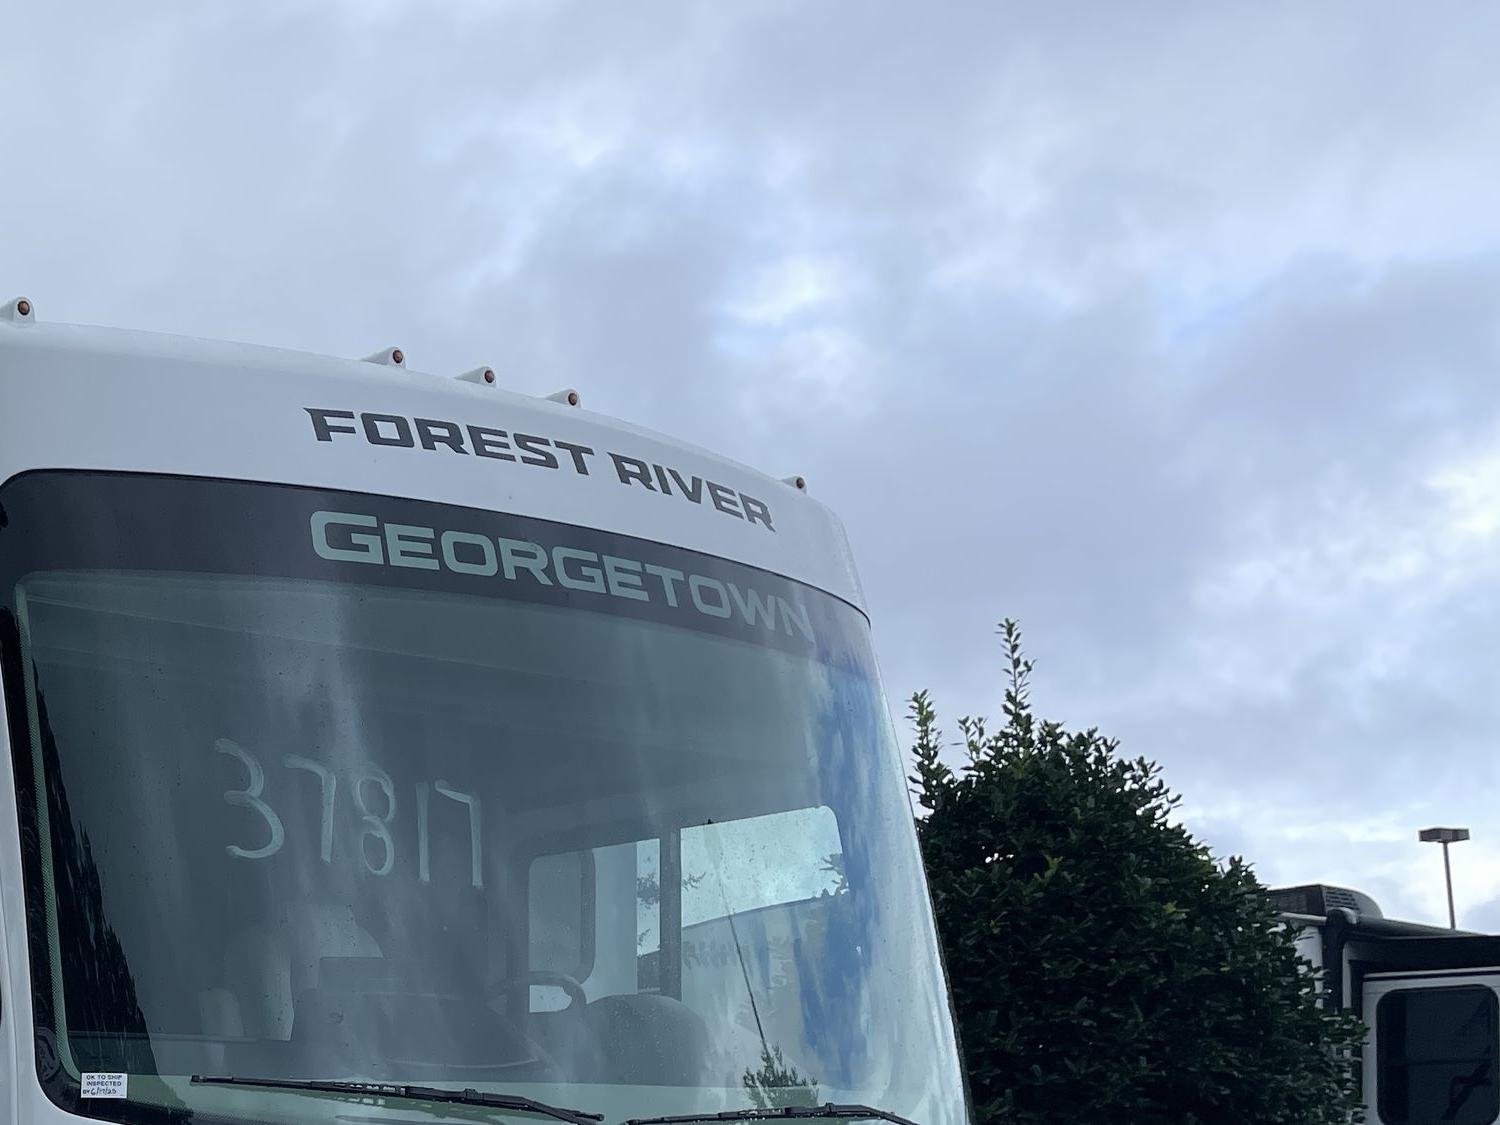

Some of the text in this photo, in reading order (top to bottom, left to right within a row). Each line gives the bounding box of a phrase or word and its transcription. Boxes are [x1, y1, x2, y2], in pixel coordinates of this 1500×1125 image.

[303, 406, 778, 533] FOREST RIVER
[309, 509, 816, 642] GEORGETOWN
[213, 737, 485, 889] 37817
